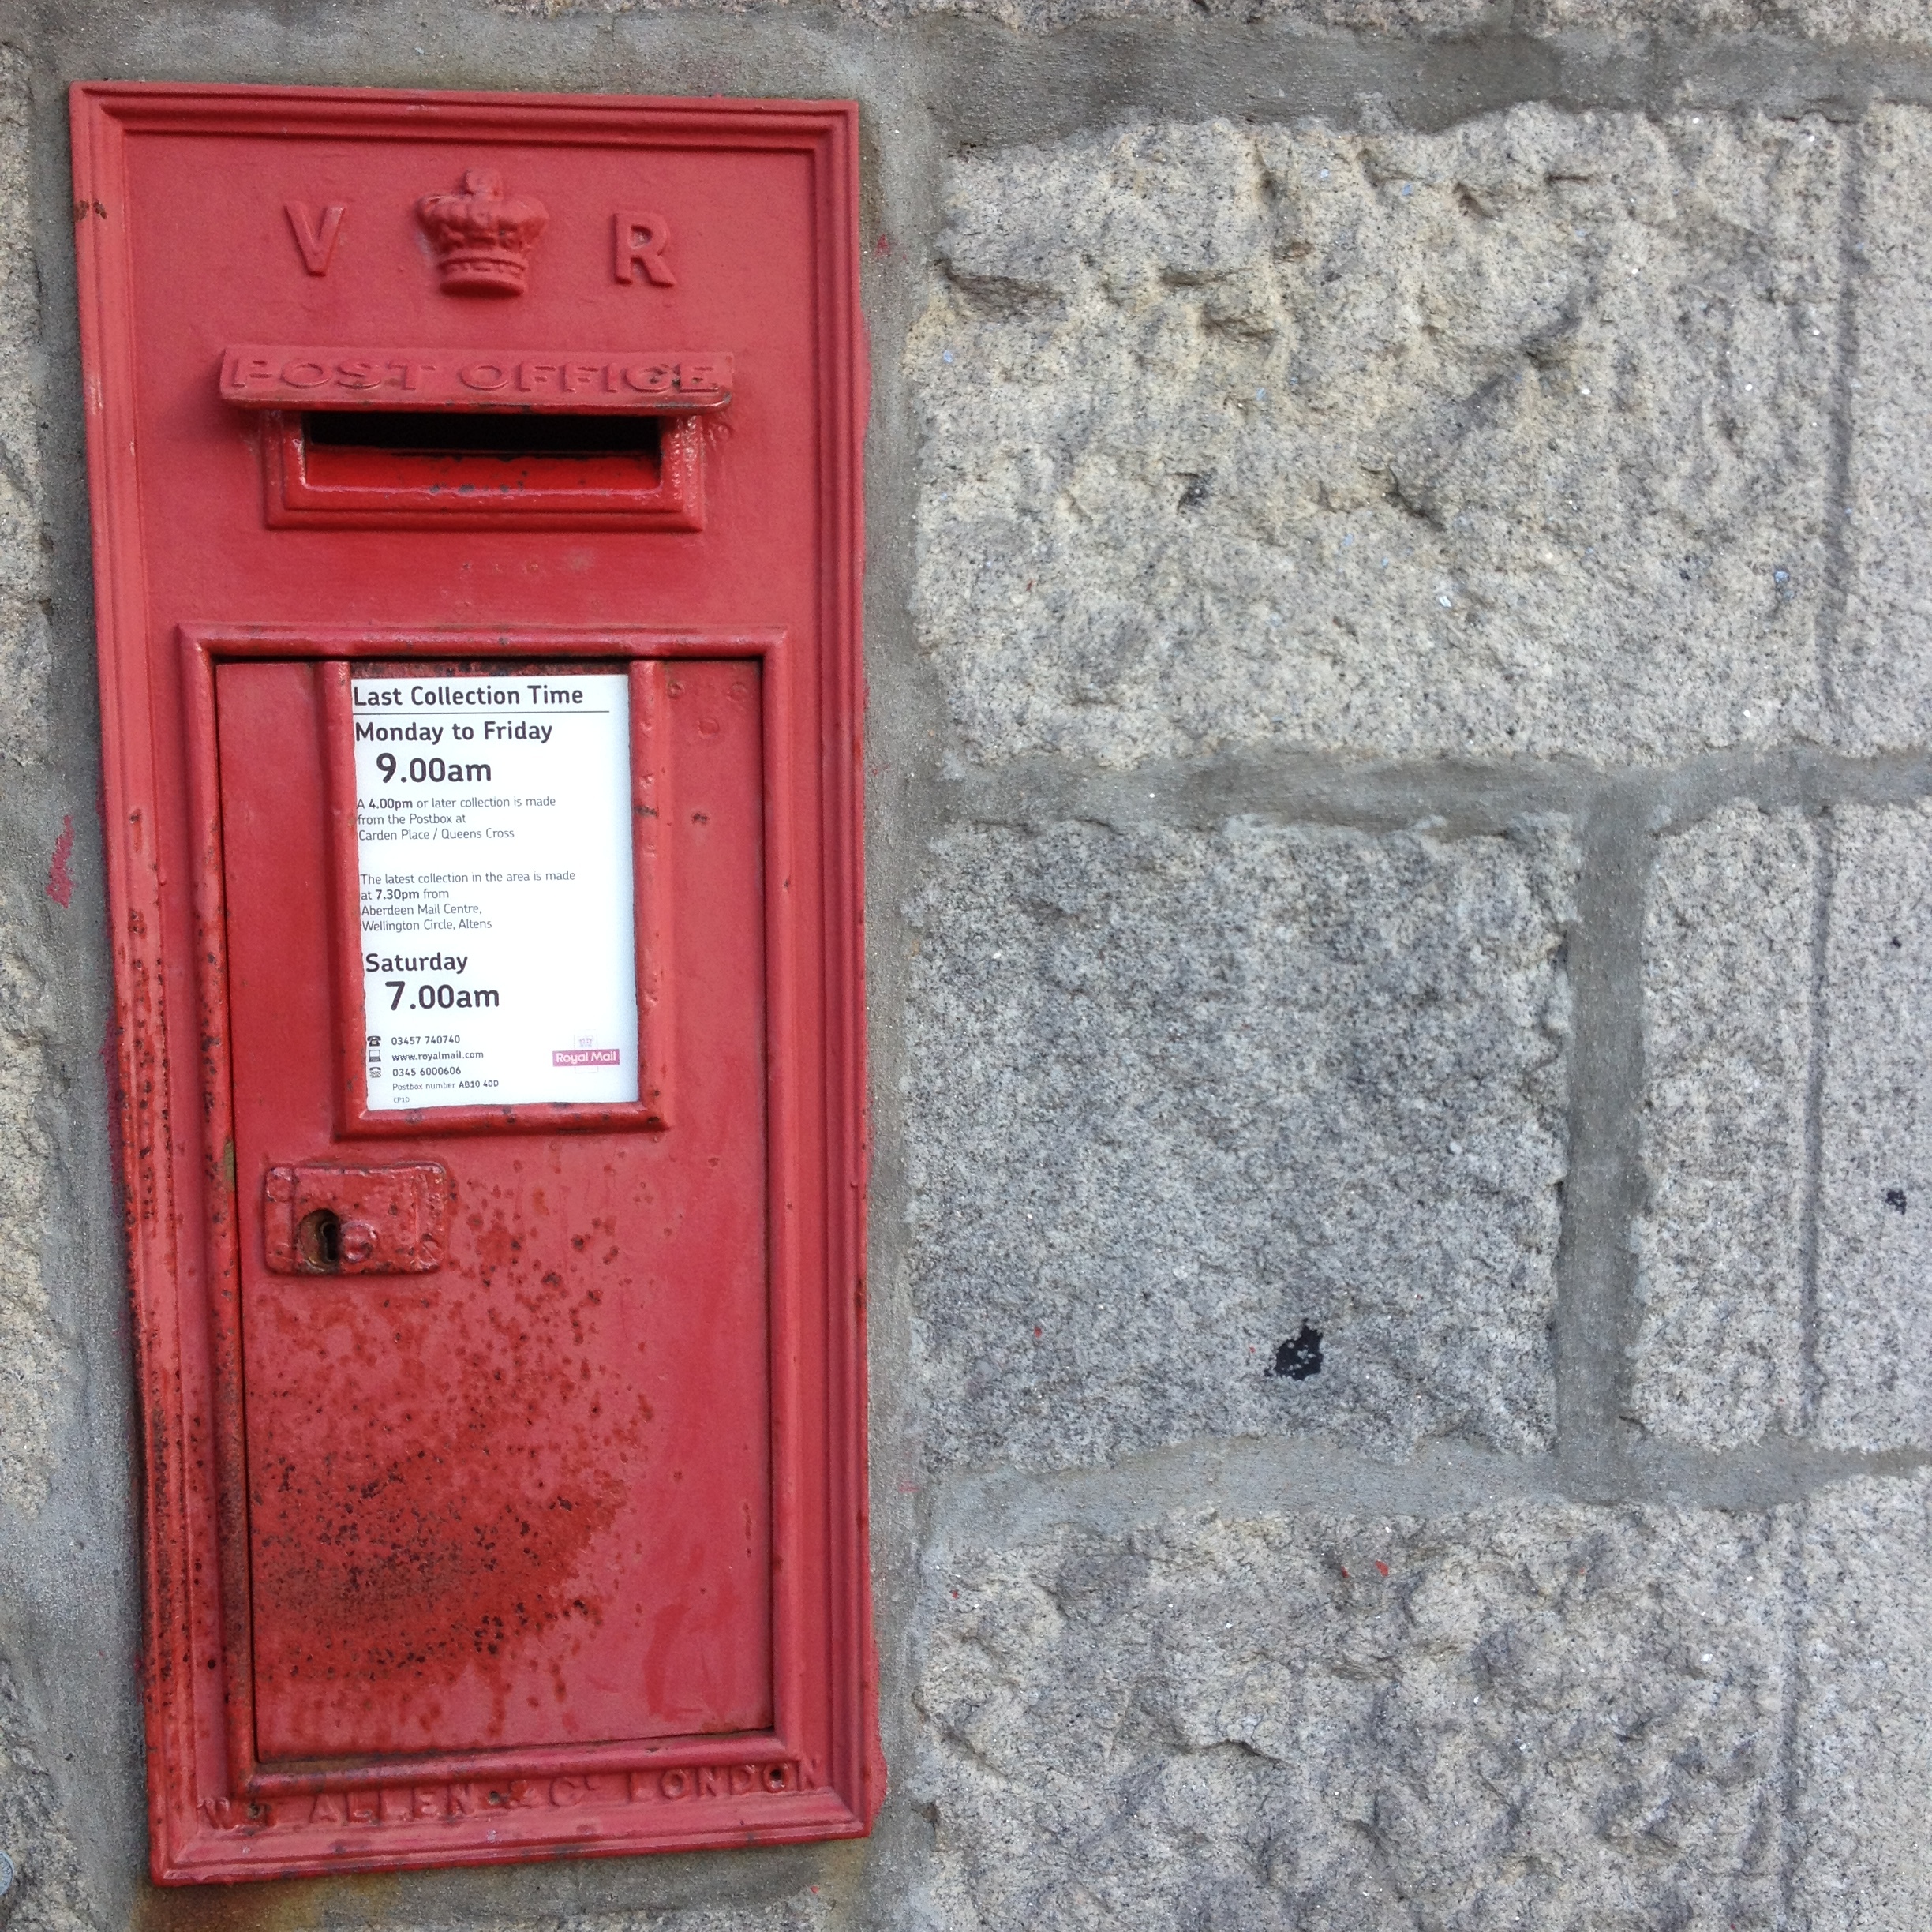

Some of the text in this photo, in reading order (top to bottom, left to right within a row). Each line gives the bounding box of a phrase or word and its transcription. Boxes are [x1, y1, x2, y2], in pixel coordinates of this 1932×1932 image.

[283, 200, 676, 287] V R
[231, 355, 718, 395] POST OFFICE
[354, 685, 583, 706] Last Collection Time
[355, 721, 552, 745] Monday to Friday
[376, 752, 492, 783] 9.00am
[358, 796, 556, 811] A 4.00pm or later collection is made
[358, 814, 466, 825] from the Postbox at
[359, 829, 515, 841] Carden Place / Queens Cross
[361, 871, 575, 885] The latest collection in the area is made
[361, 889, 449, 902] at 7.30pm from
[361, 904, 482, 915] Aberdeen Mail Centre,
[362, 919, 492, 933] Wellington Circle, Altens
[365, 952, 468, 974] Saturday
[385, 981, 499, 1010] 7.00am
[425, 1035, 460, 1044] 740740
[392, 1051, 484, 1061] www.royalmail.com
[556, 1051, 616, 1065] Royal Mail
[392, 1067, 461, 1076] 0345 6000606
[309, 1785, 475, 1827] ALLEN
[628, 1758, 821, 1803] LONDON
